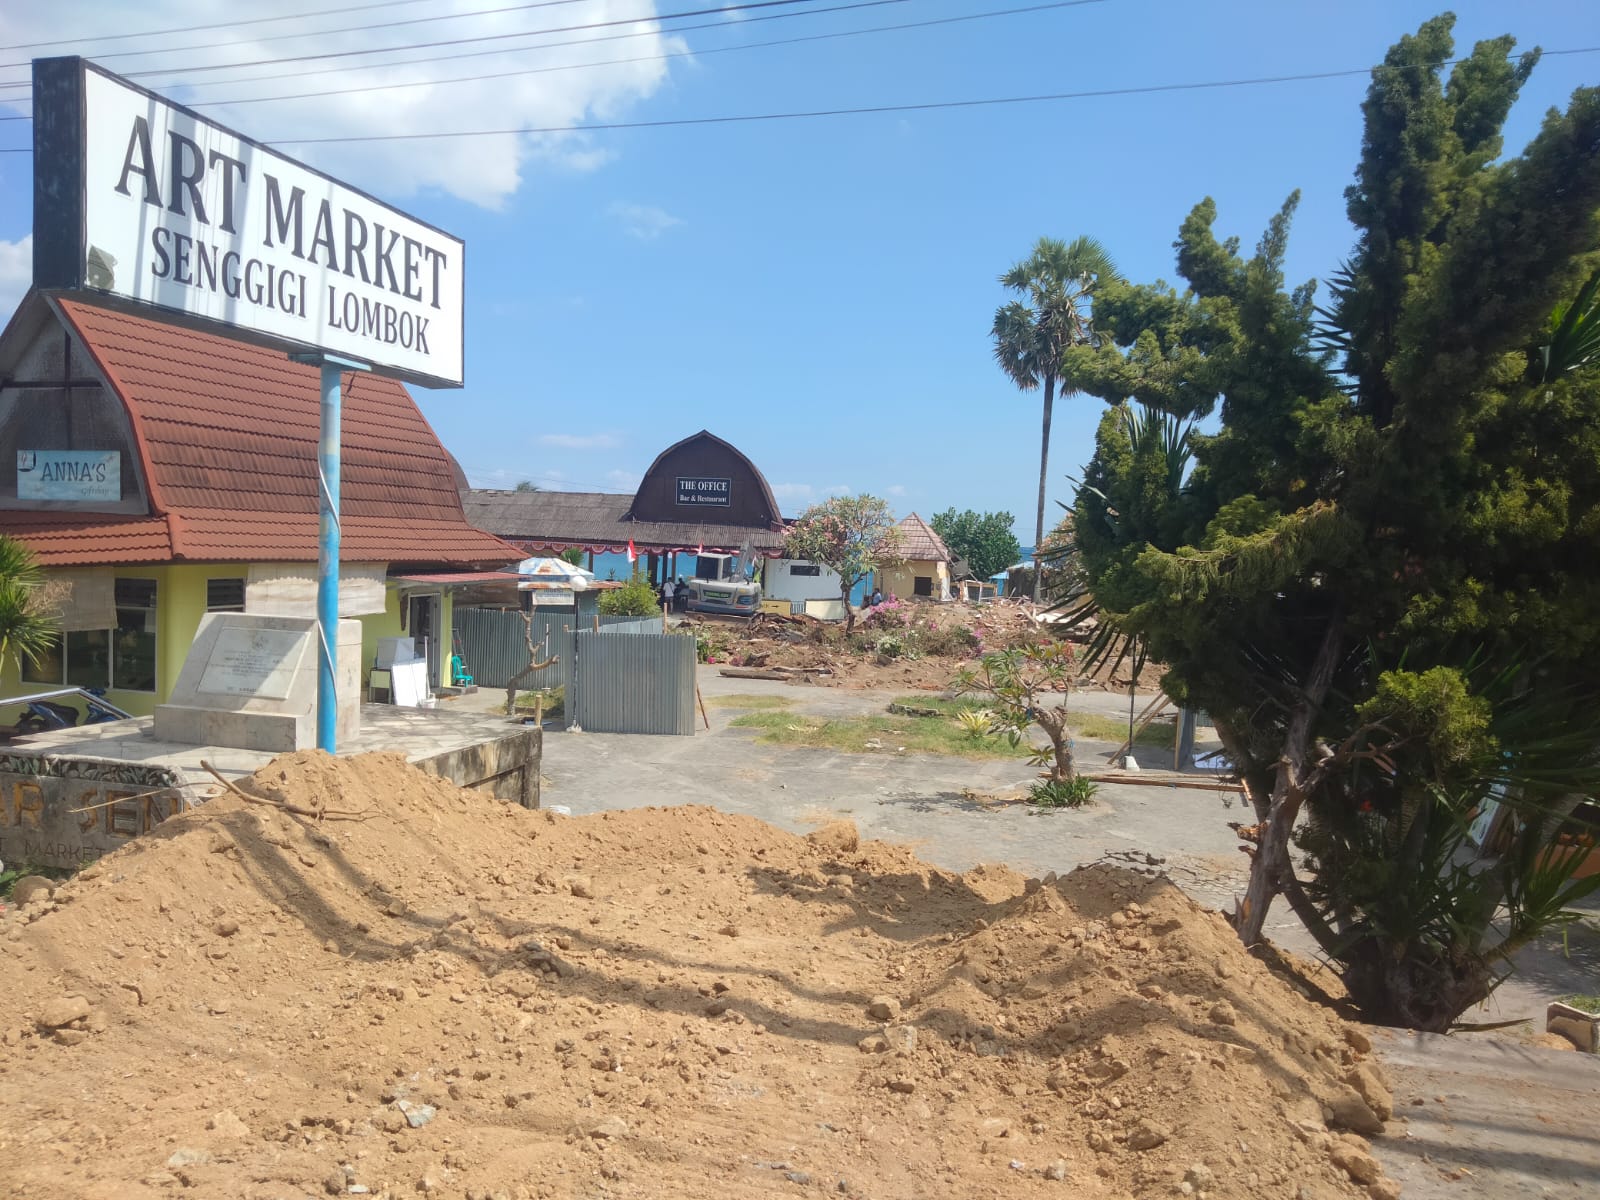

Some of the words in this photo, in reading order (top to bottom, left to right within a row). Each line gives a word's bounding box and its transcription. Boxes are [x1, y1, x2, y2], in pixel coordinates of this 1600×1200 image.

[114, 115, 247, 235] ART
[263, 172, 447, 310] MARKET
[151, 226, 307, 318] SENGGIGI
[328, 285, 430, 355] LOMBOK
[40, 461, 106, 482] ANNA'S
[680, 480, 697, 490] THE
[698, 481, 727, 491] OFFICE
[680, 494, 690, 502] Bar
[691, 494, 696, 502] &
[697, 495, 727, 503] Restaurant
[24, 839, 106, 862] MARKET
